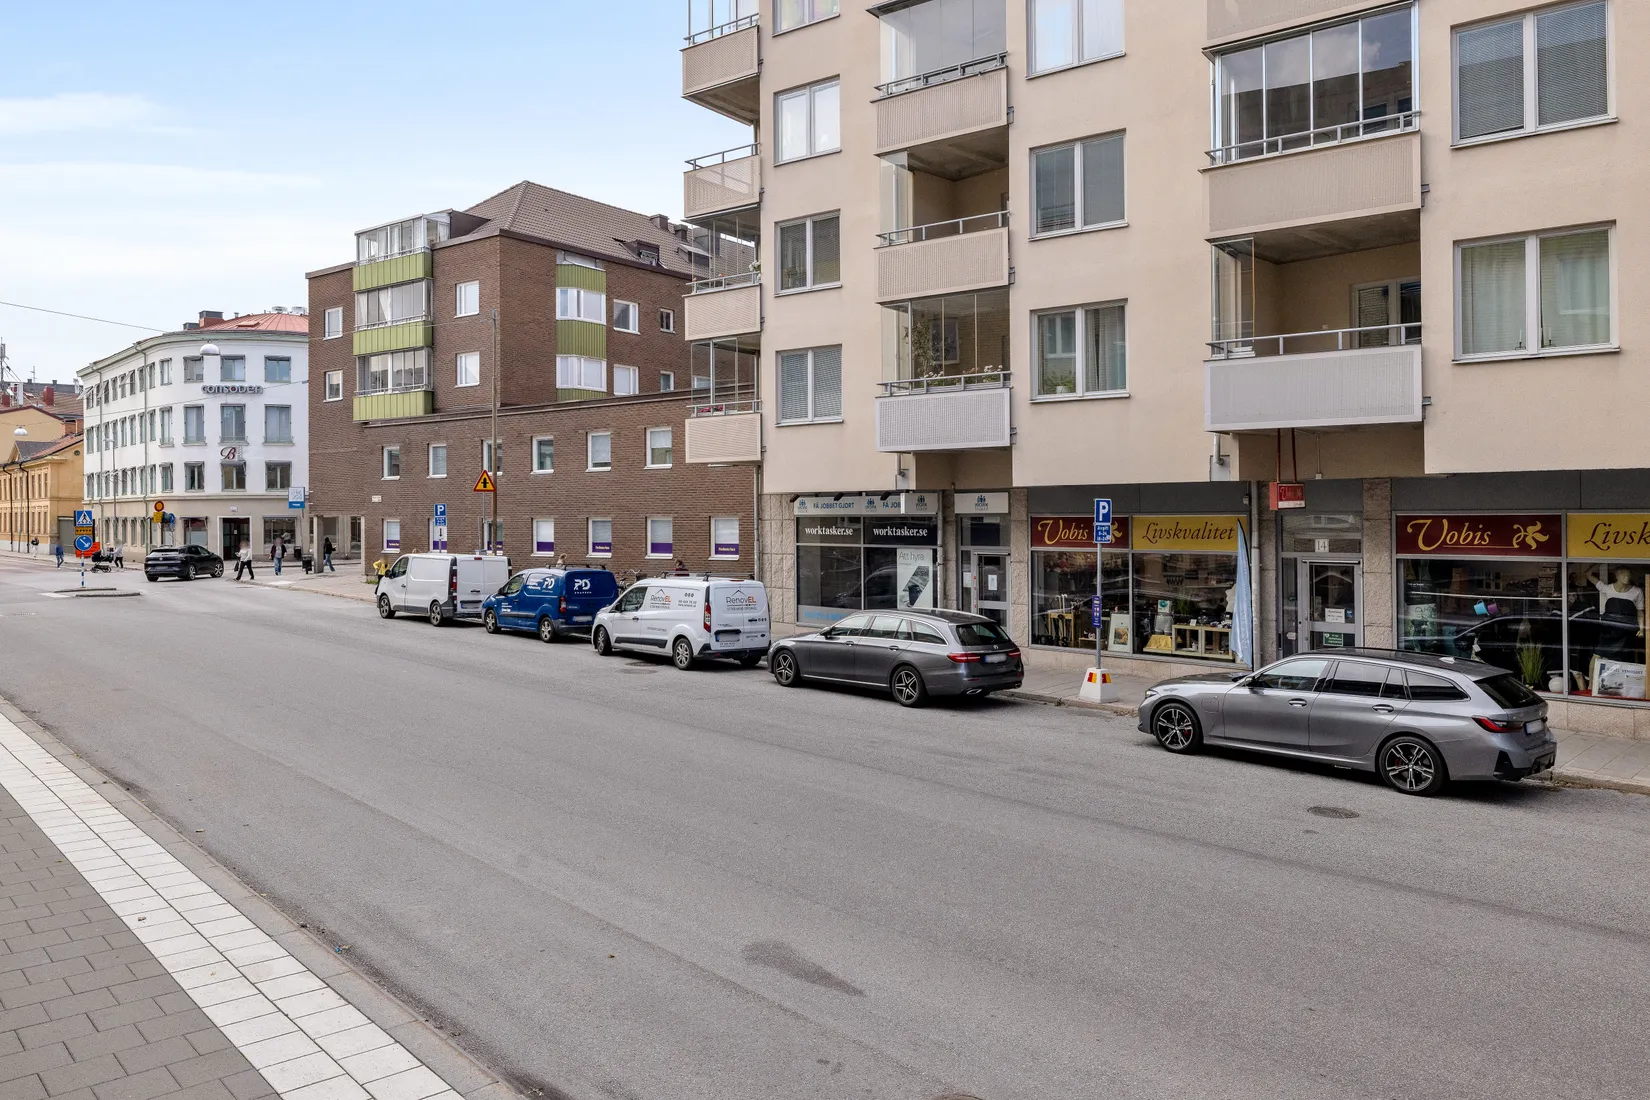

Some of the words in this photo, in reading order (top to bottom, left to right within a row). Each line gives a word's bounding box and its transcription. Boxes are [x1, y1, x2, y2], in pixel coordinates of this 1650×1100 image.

[437, 504, 444, 516] P
[1099, 501, 1109, 521] P
[805, 526, 854, 536] worktasker.se
[873, 526, 928, 536] worktasker.se
[1037, 519, 1088, 545] Vobis
[1142, 521, 1235, 544] Livskvalitet
[1406, 518, 1491, 551] Vobis
[1317, 541, 1327, 551] 14
[899, 551, 910, 560] Att
[911, 551, 924, 562] hyra
[726, 596, 757, 604] RenovEL
